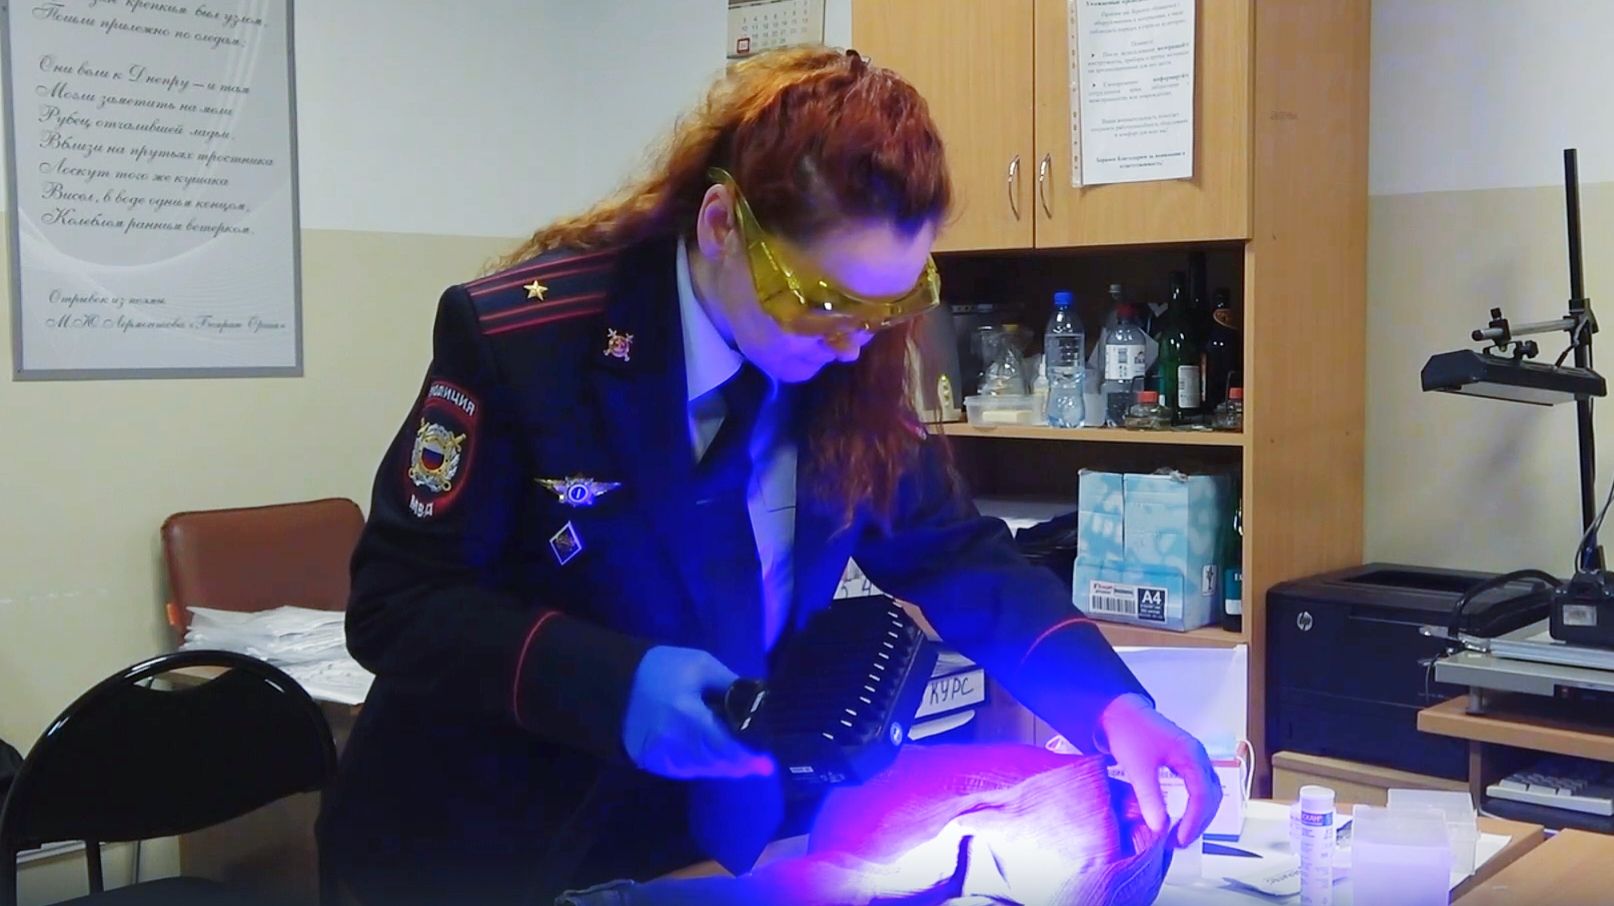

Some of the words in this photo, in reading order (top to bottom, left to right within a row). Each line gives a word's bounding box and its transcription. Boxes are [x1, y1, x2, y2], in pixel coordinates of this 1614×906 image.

[32, 3, 95, 25] Пошли
[100, 18, 170, 36] прилежно
[174, 31, 191, 39] по
[195, 4, 219, 18] был
[40, 55, 73, 73] Они
[112, 71, 123, 80] к
[127, 64, 189, 93] Днепру
[207, 82, 216, 91] и
[220, 84, 250, 94] там
[35, 82, 95, 101] Могли
[96, 95, 175, 110] заметить
[180, 103, 197, 113] на
[38, 104, 91, 130] Рубец
[95, 118, 184, 134] отчалившей
[39, 130, 103, 159] Вблизи
[107, 145, 125, 155] на
[130, 145, 193, 163] прутьях
[197, 151, 273, 167] тростника
[39, 157, 110, 183] Лоскут
[115, 171, 149, 181] того
[152, 175, 171, 183] же
[174, 175, 229, 190] кушака
[115, 189, 145, 211] воде
[149, 198, 192, 213] одним
[124, 218, 182, 234] ранним
[48, 288, 109, 308] Отрывок
[111, 297, 124, 309] из
[409, 493, 434, 518] МВД
[1142, 590, 1162, 605] A4
[930, 677, 974, 705] КУРС
